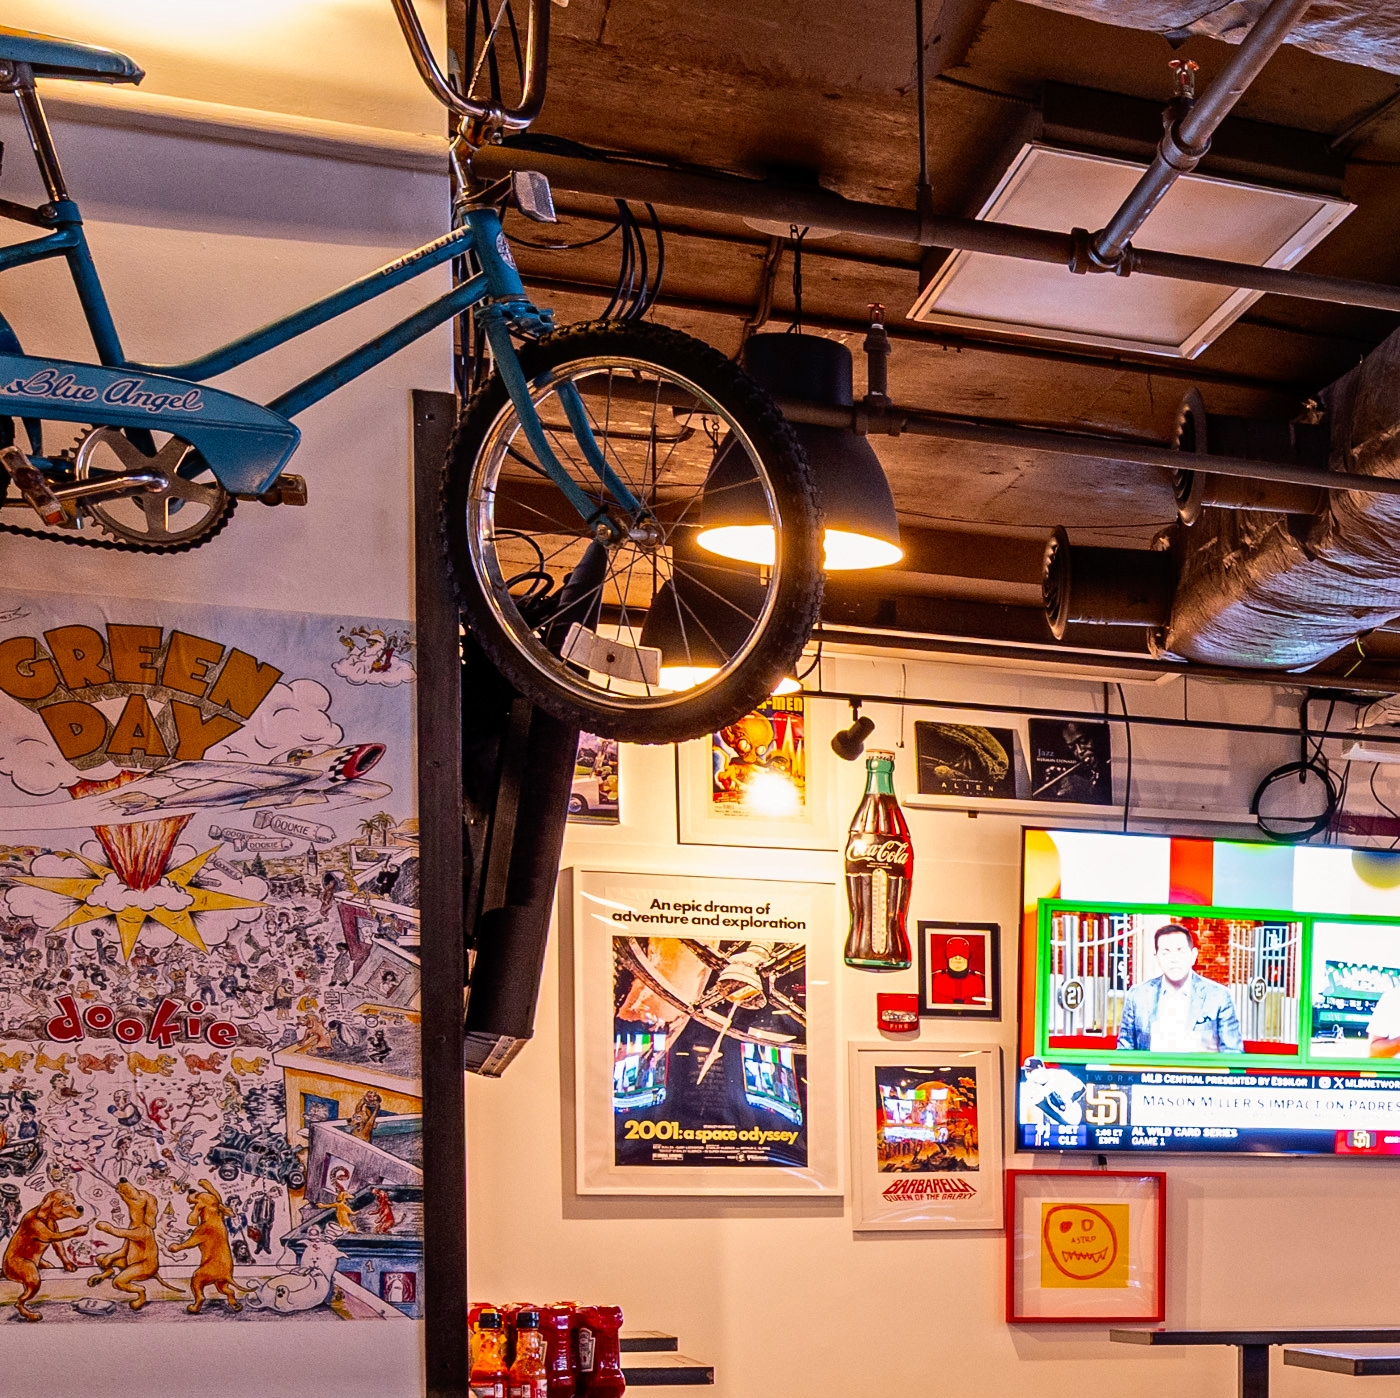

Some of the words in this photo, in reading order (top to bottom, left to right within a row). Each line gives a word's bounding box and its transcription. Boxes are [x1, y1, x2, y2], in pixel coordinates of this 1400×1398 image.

[6, 368, 98, 401] Blue
[103, 378, 203, 413] Angel
[0, 624, 283, 721] GREEN
[40, 693, 242, 761] DAY
[1037, 748, 1055, 758] Jazz
[941, 782, 994, 792] ALIEN
[274, 819, 310, 836] DOOKIE
[845, 840, 910, 865] Coca-Cola
[650, 899, 670, 911] An
[673, 901, 703, 916] epic
[704, 901, 752, 914] drama
[756, 902, 771, 914] of
[612, 911, 689, 926] adventure
[691, 914, 720, 927] and
[723, 915, 806, 930] exploration
[47, 995, 240, 1051] dookie
[624, 1120, 683, 1140] 2001:
[683, 1129, 694, 1140] a
[695, 1128, 737, 1144] space
[738, 1126, 799, 1145] odyssey
[881, 1178, 977, 1194] BARBARELLA
[882, 1194, 914, 1202] QUEEN
[1071, 1236, 1096, 1244] ASTRO
